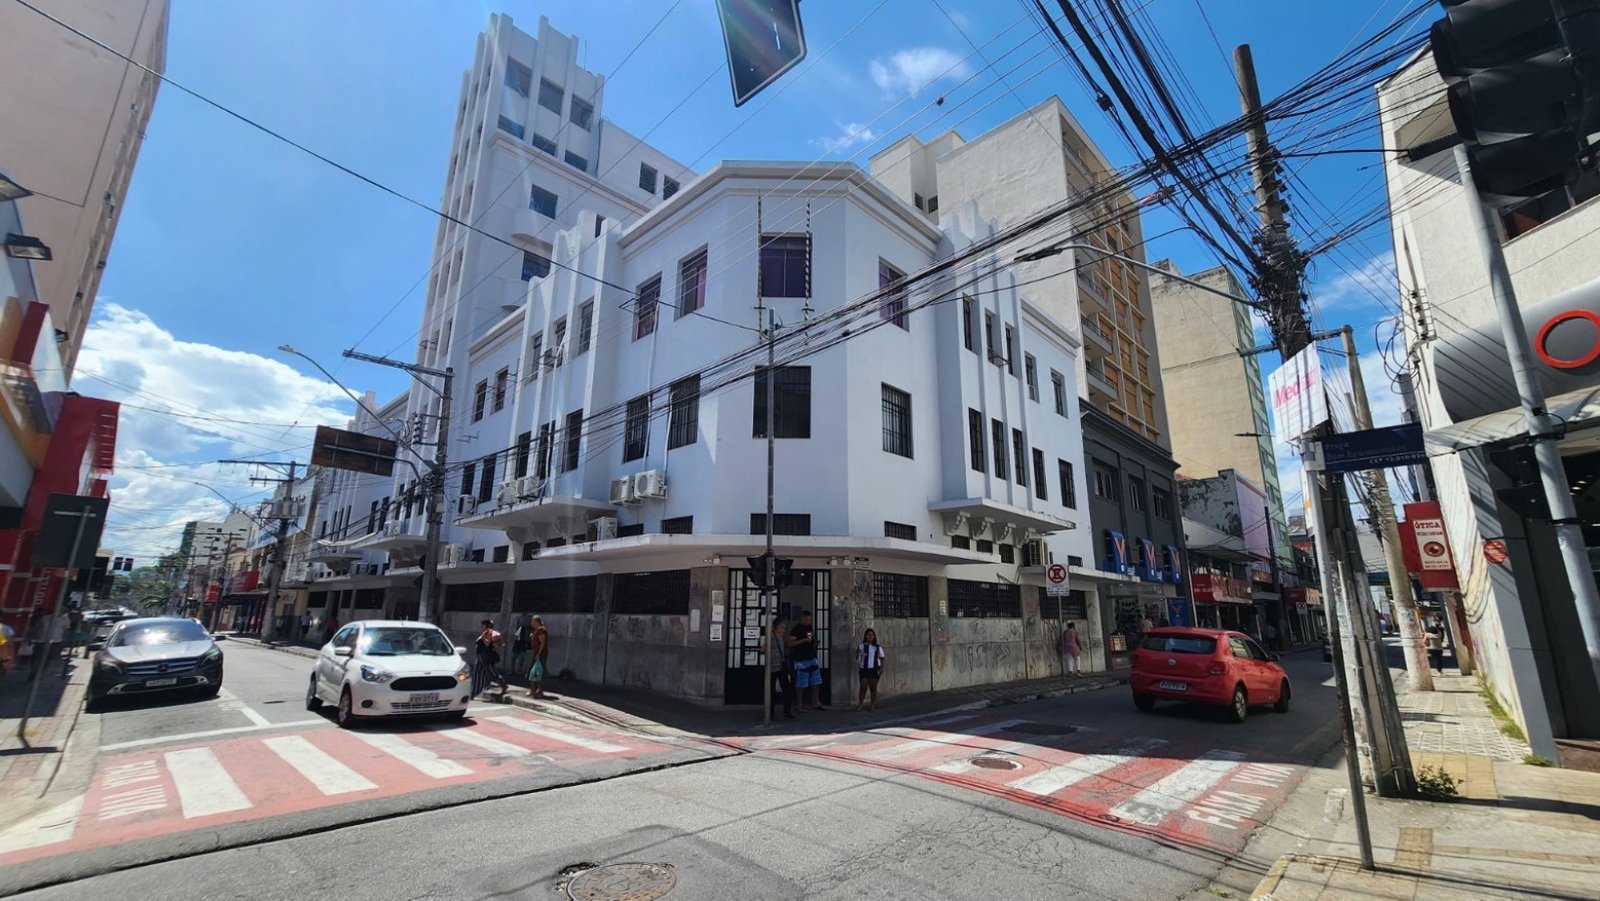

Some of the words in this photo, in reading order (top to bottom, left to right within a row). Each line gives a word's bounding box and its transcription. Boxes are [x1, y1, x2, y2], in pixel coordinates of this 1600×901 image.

[1414, 520, 1441, 529] ÓTICA
[1185, 790, 1268, 830] FAIXA
[1230, 762, 1295, 788] VIVA
